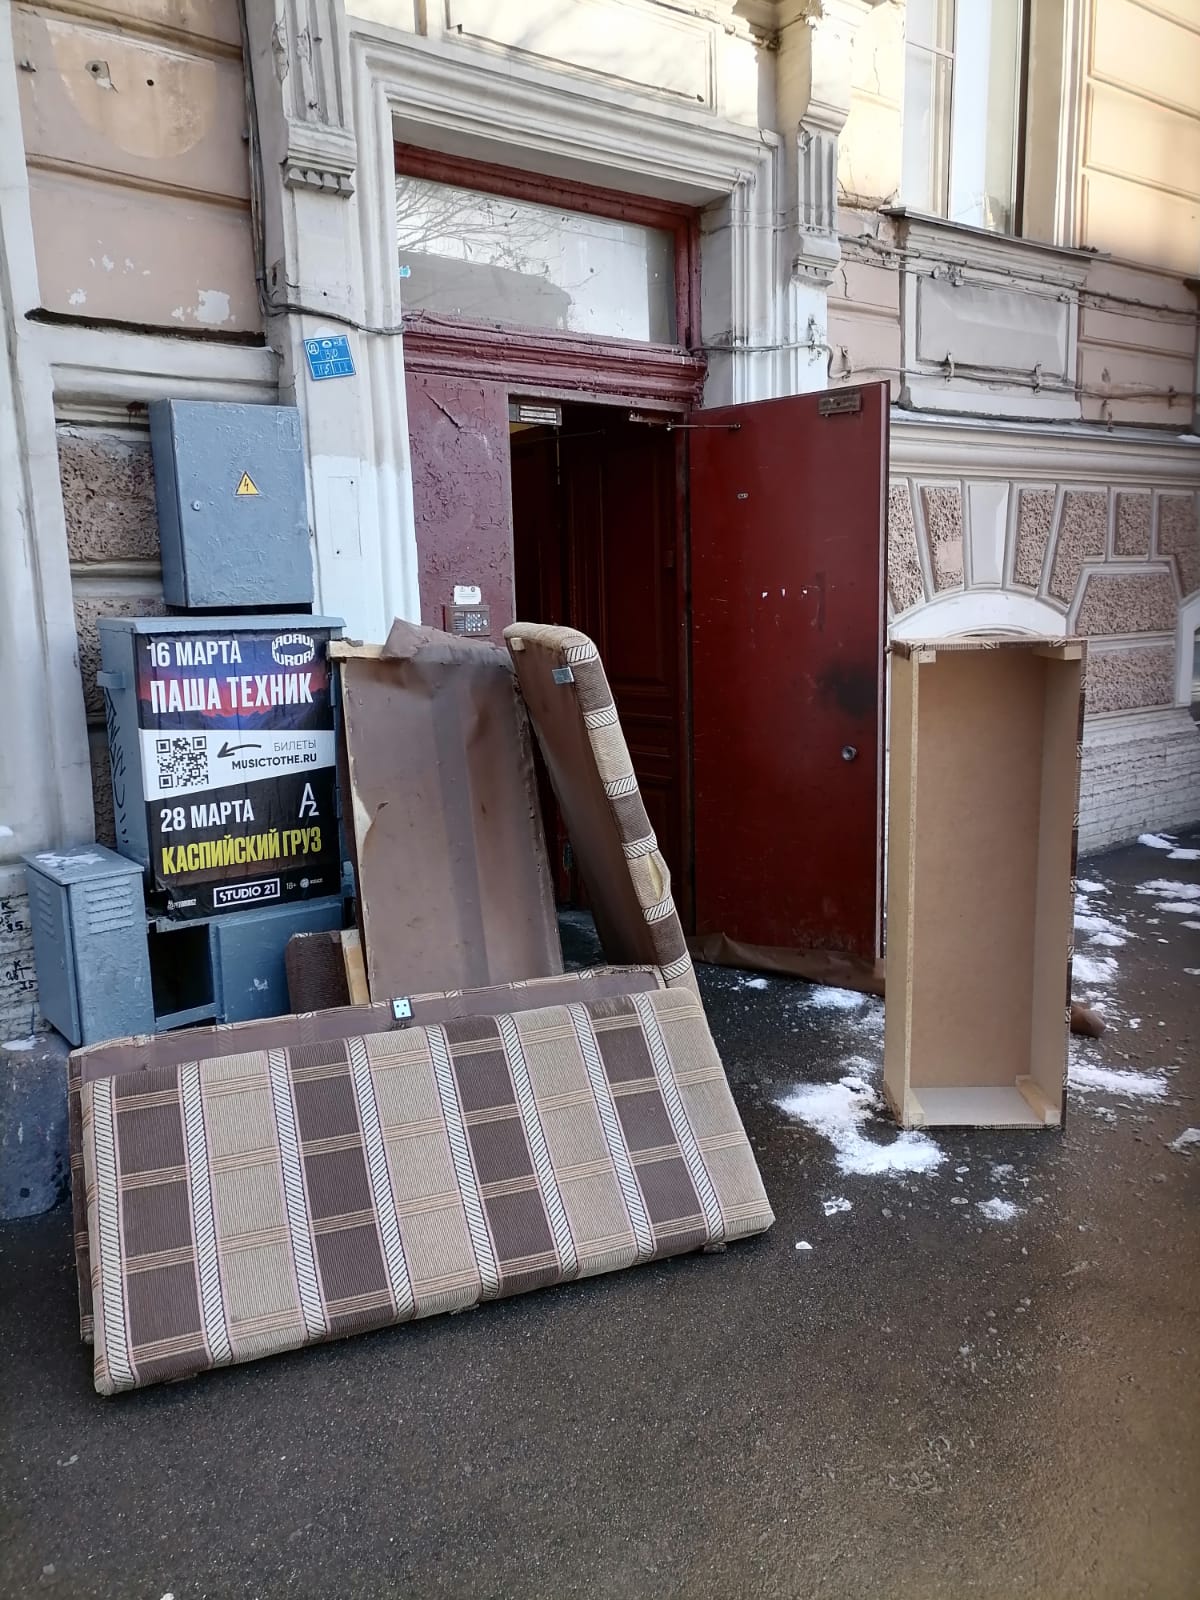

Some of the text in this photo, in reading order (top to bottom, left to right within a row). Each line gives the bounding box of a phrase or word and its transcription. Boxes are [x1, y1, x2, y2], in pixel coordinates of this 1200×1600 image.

[147, 640, 242, 667] 16 МАРТА
[150, 672, 314, 714] ПАША ТЕХНИК
[273, 739, 317, 752] БИЛЕТЫ
[231, 753, 317, 770] MUSICTOTHE.RU
[160, 799, 255, 833] 28 МАРТА
[161, 826, 322, 875] КАСПИЙСКИЙ ГРУЗ
[219, 883, 276, 902] STUDIO 21
